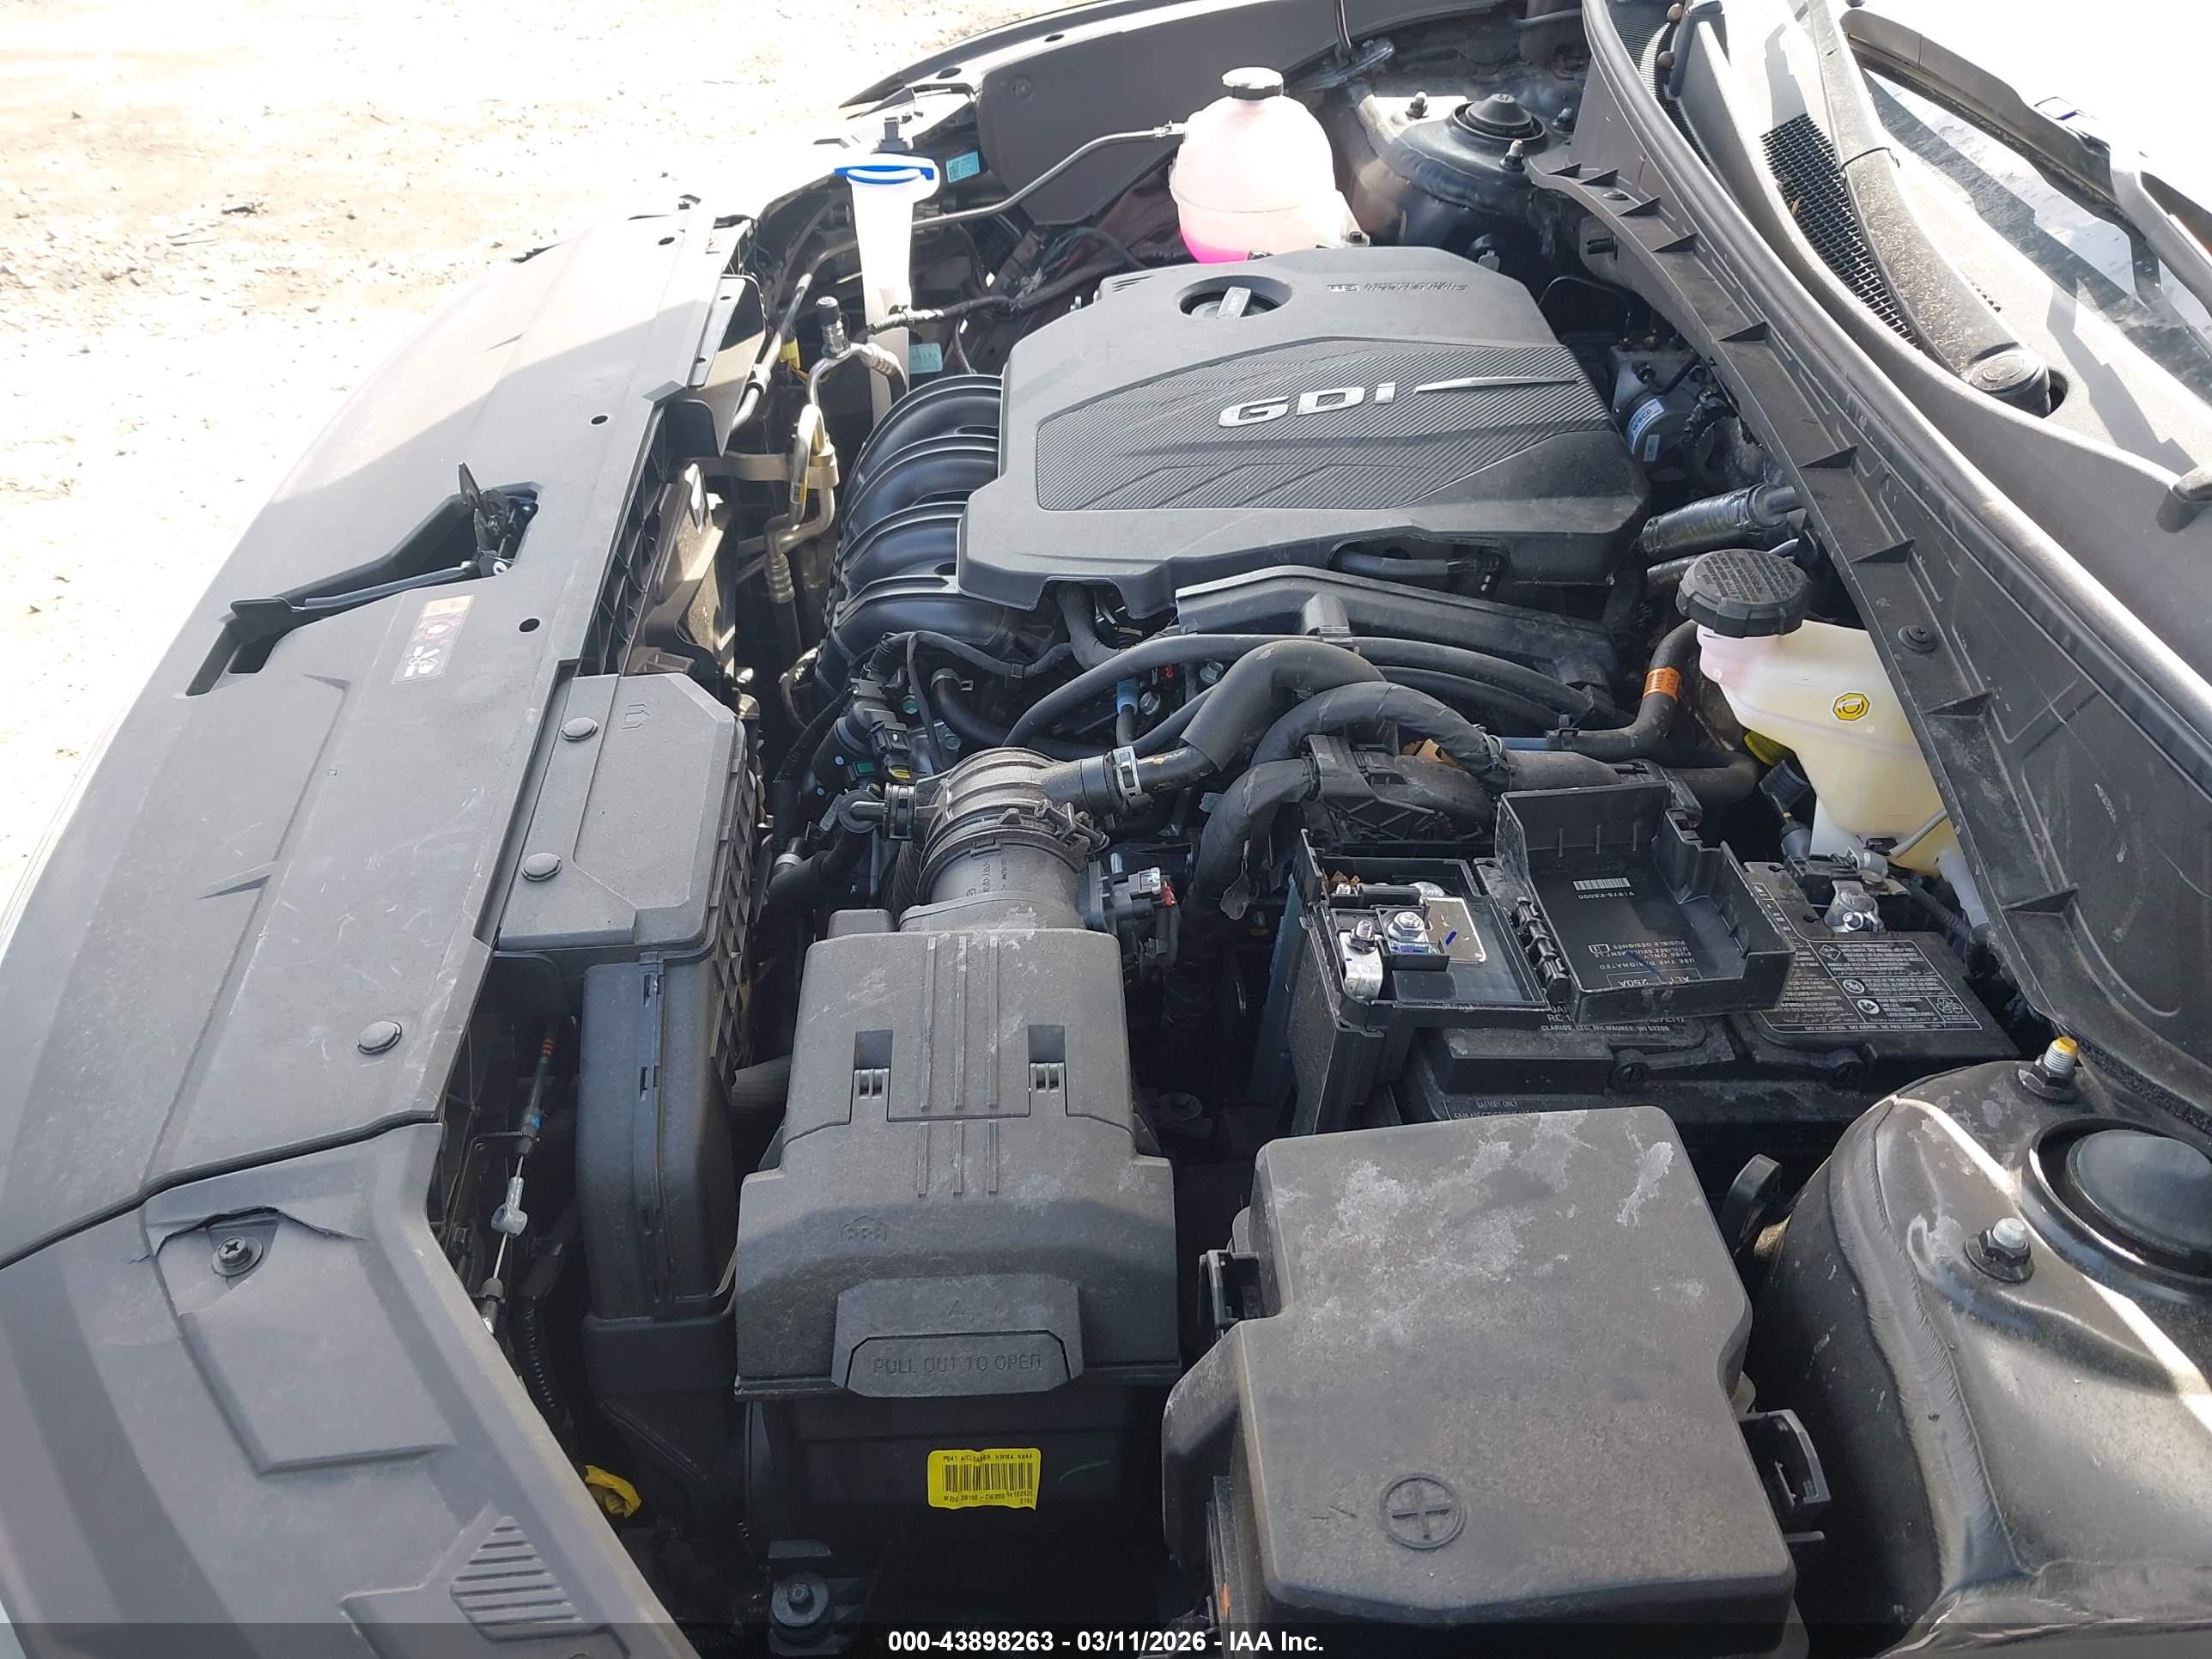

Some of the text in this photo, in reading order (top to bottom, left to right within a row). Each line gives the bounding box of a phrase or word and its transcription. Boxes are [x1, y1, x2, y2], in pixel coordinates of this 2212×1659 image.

[1599, 960, 1656, 969] DSIGNATED
[1617, 978, 1650, 988] 250A
[1547, 1013, 1564, 1022] RC
[873, 1353, 1042, 1374] PULL OUT TO OPEN
